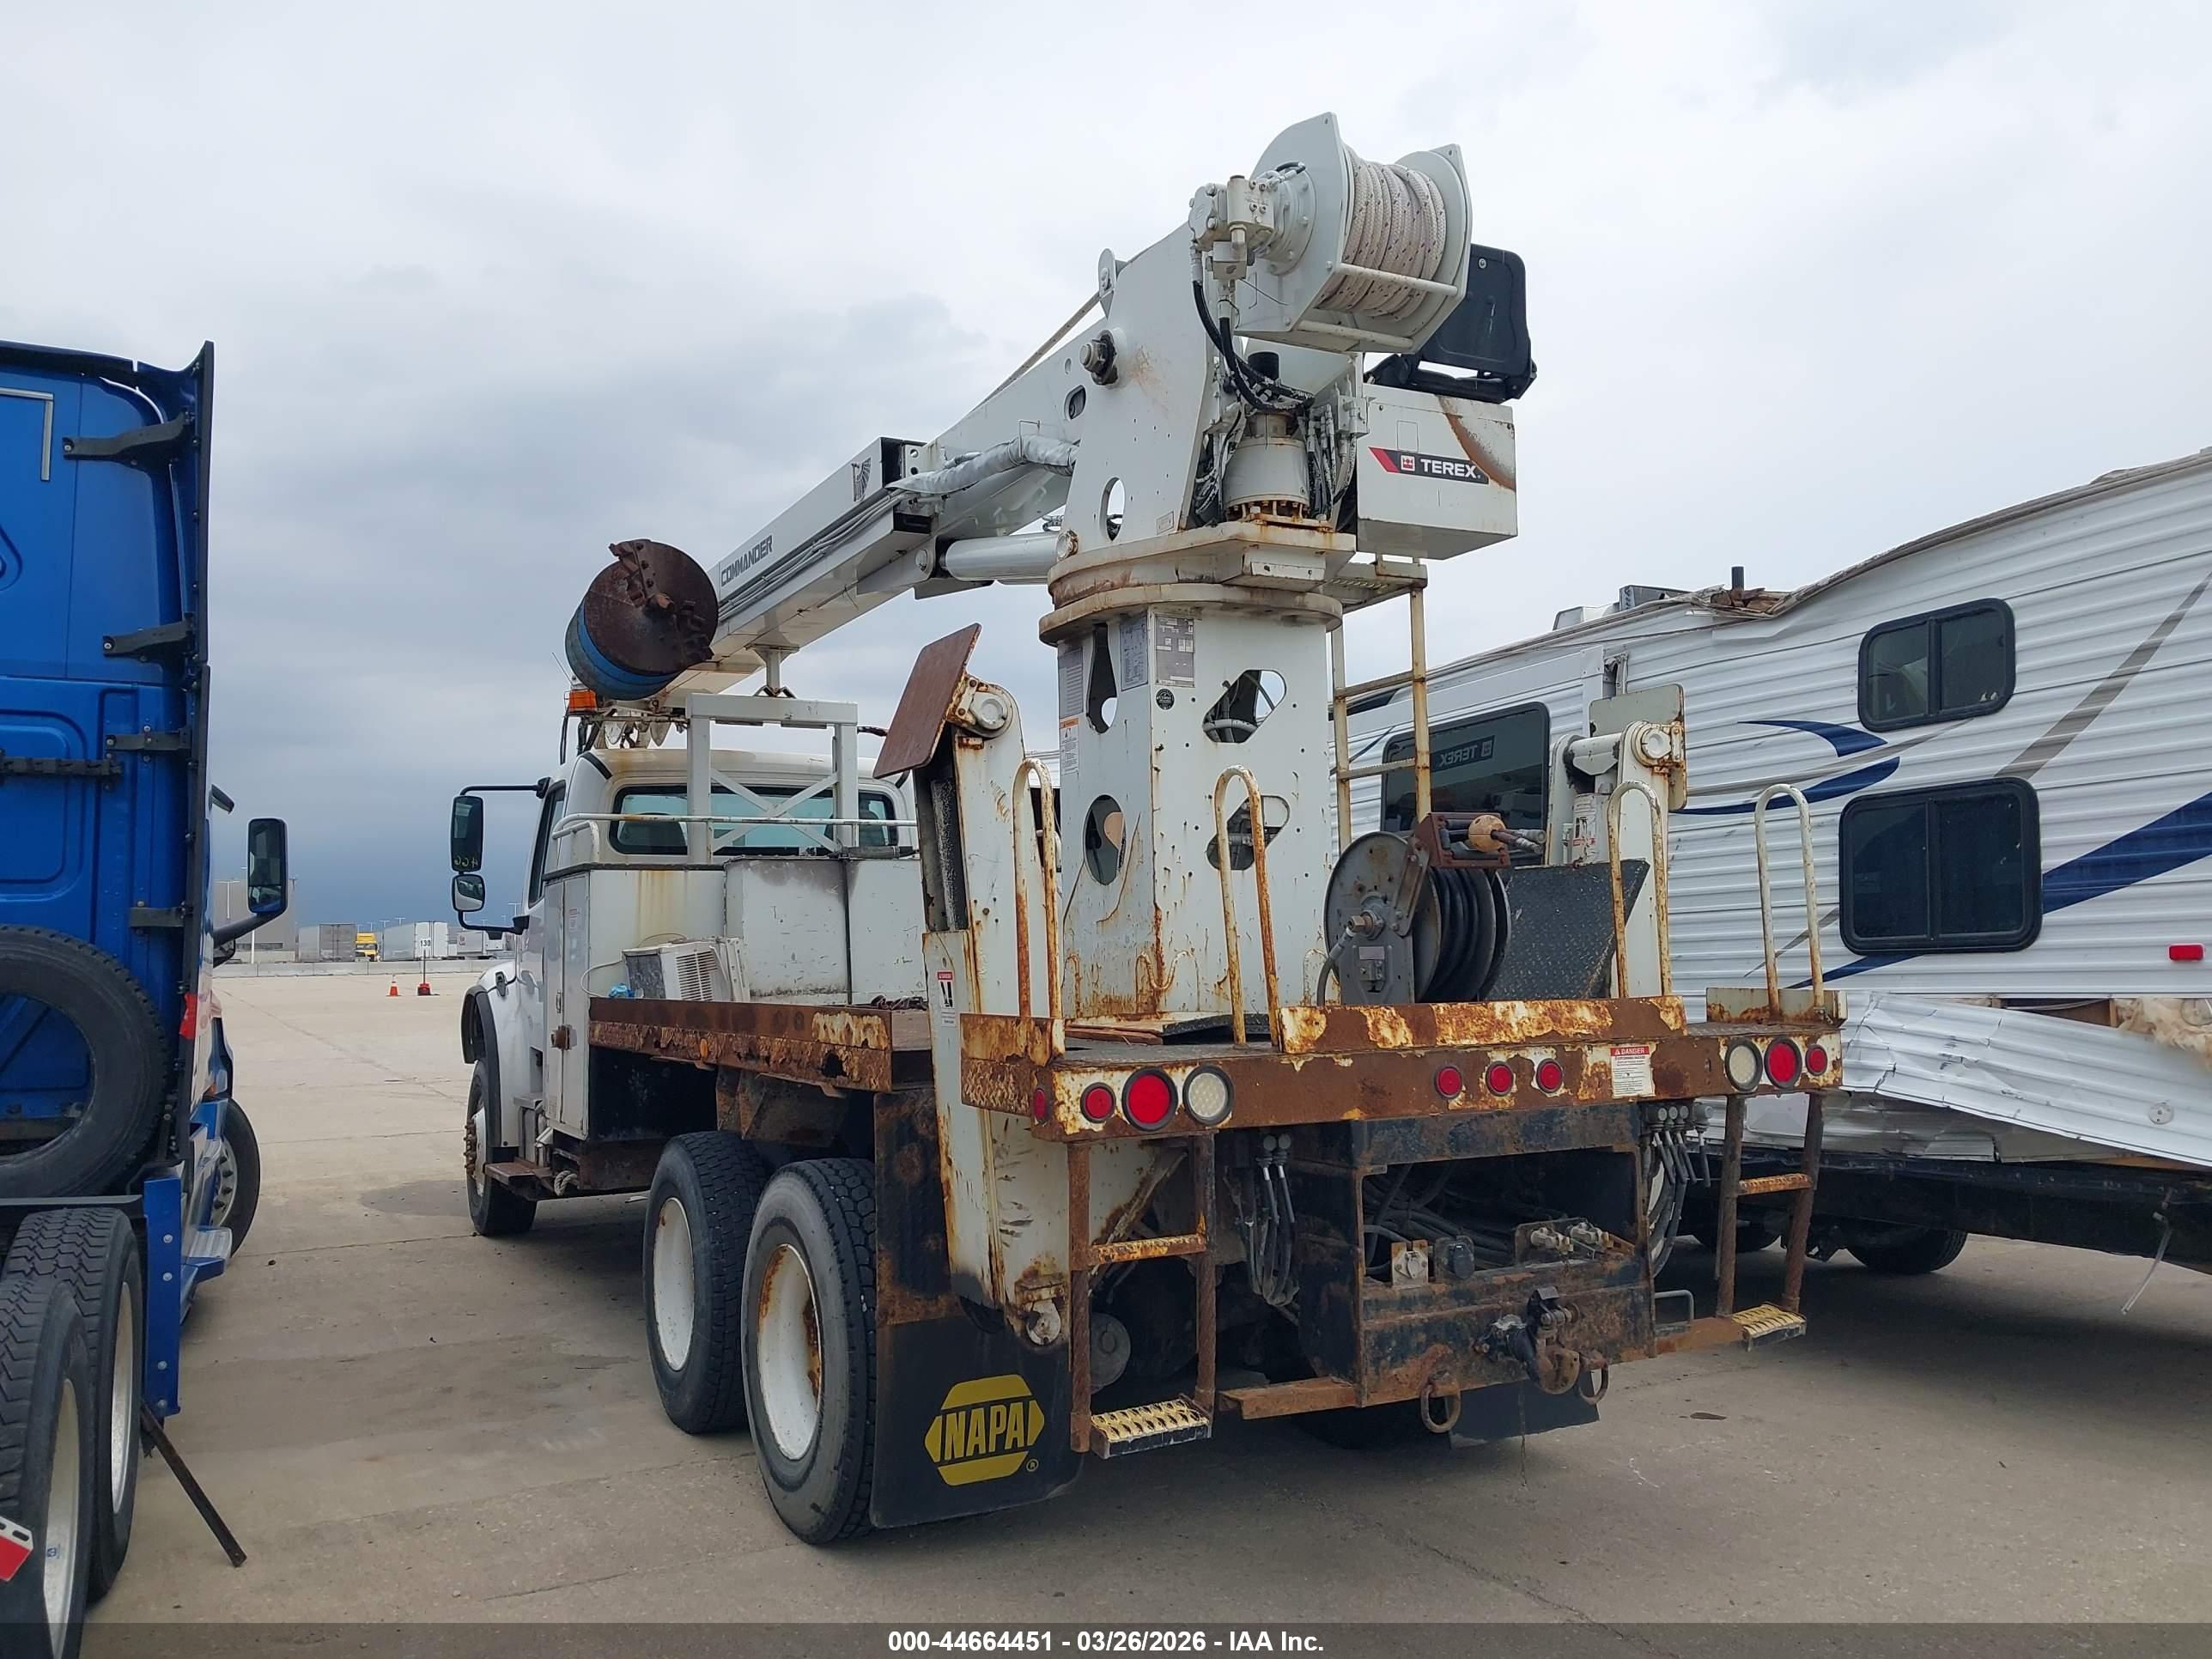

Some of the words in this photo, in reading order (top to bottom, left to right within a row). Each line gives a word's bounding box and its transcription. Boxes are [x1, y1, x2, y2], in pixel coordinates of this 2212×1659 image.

[1420, 459, 1476, 478] TEREX
[721, 535, 772, 587] COMMANDER
[945, 1402, 1024, 1460] NAPA
